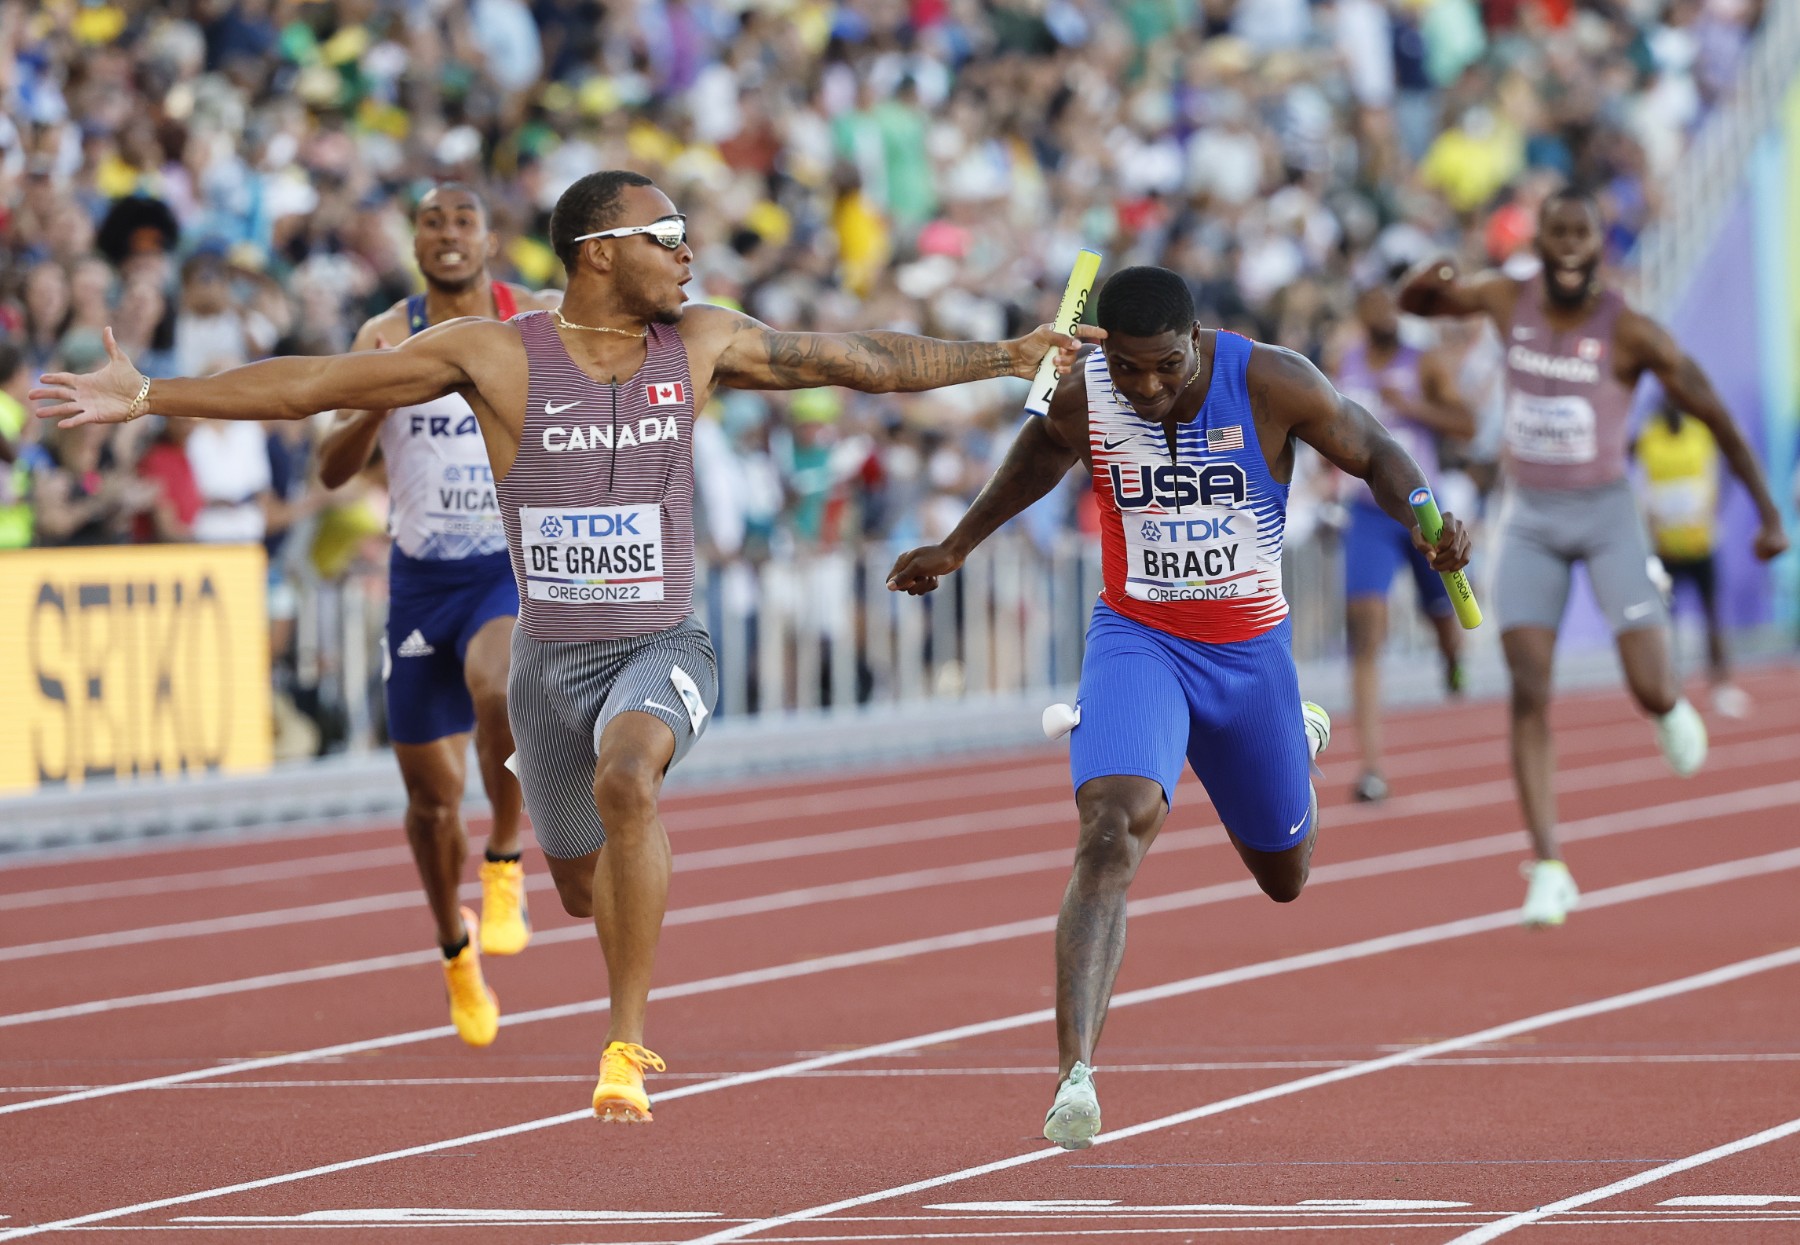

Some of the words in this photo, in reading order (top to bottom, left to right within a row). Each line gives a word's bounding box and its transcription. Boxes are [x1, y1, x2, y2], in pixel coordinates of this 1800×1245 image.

[542, 416, 679, 451] CANADA
[1109, 462, 1247, 510] USA
[562, 513, 640, 537] TDK
[1160, 516, 1236, 542] TDK
[531, 545, 559, 572] DE
[566, 543, 656, 574] GRASSE
[1143, 543, 1239, 579] BRACY
[548, 585, 640, 601] OREGON22
[1147, 583, 1239, 602] OREGON22
[1453, 571, 1470, 602] WORLD
[28, 574, 235, 784] SEIKO
